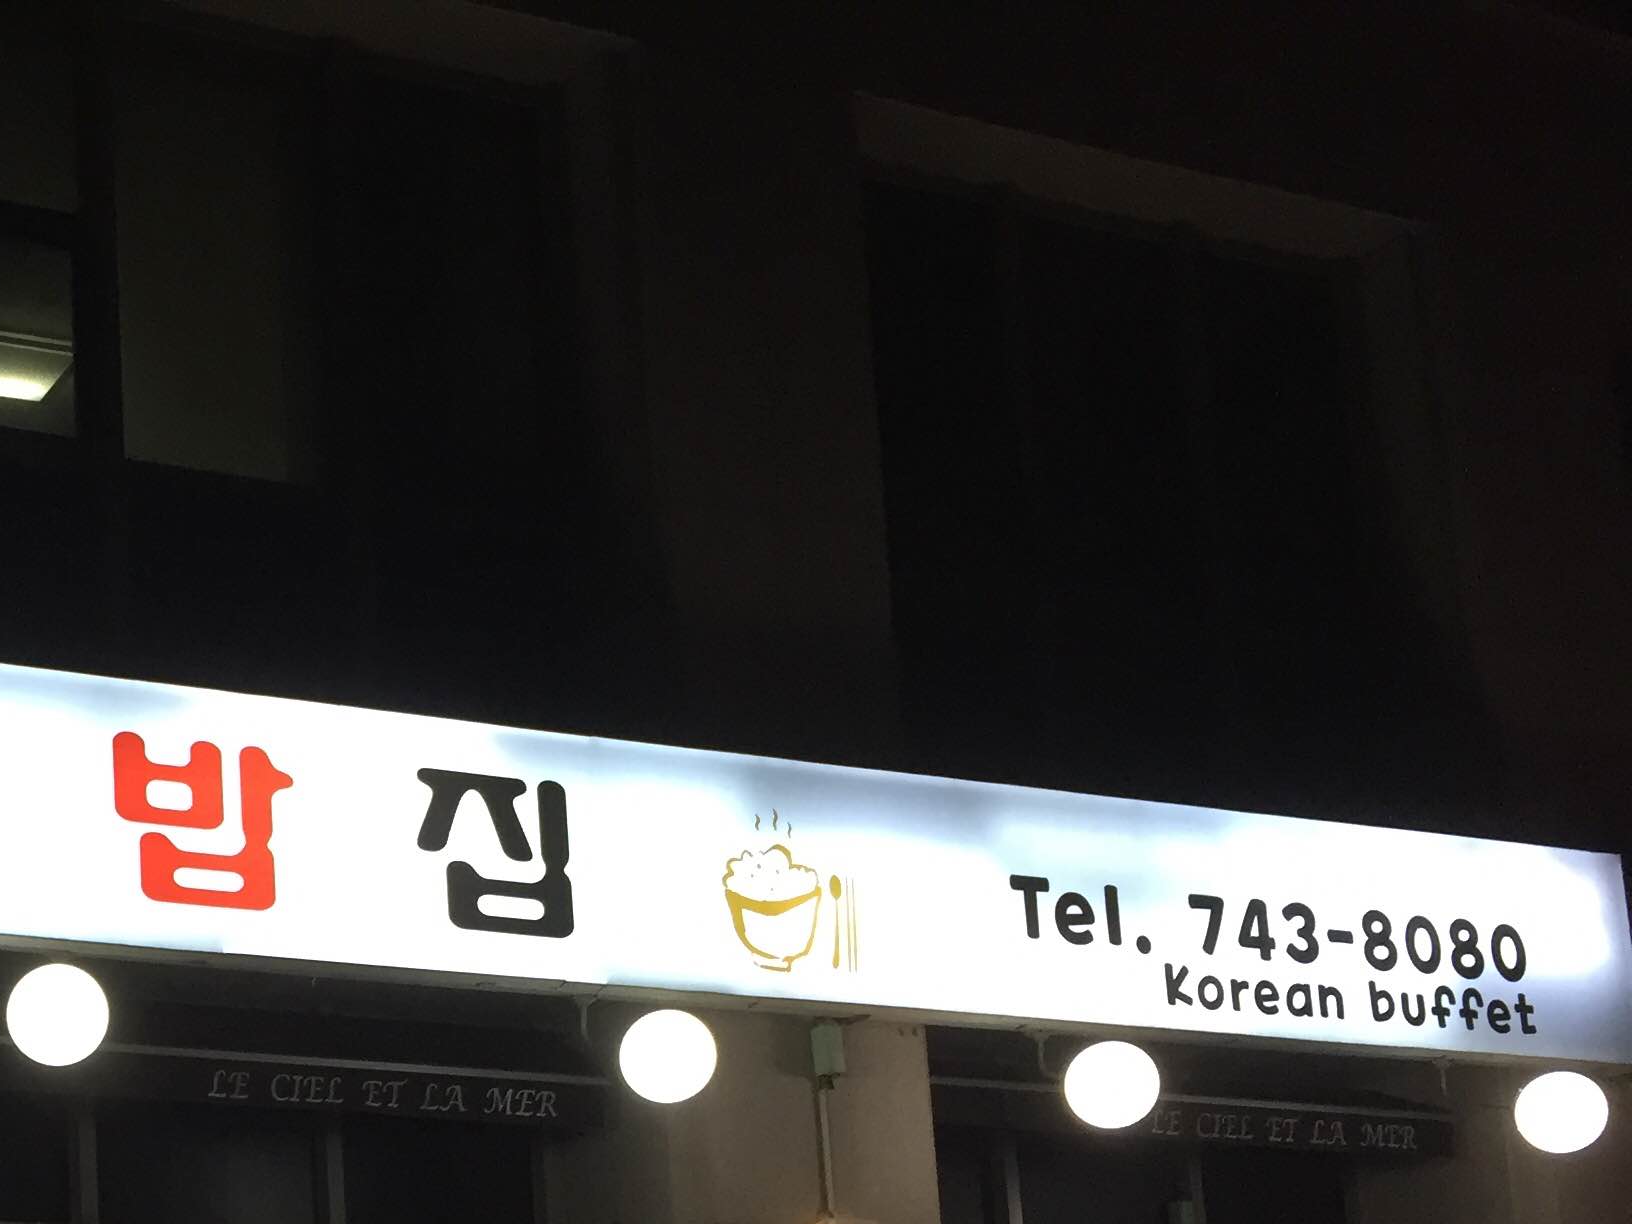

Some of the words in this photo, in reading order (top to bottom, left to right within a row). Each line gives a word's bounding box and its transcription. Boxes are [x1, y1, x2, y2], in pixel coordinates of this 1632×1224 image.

[1009, 874, 1152, 955] Tel.
[1188, 893, 1527, 983] 743-8080
[1164, 962, 1344, 1020] Korean
[1368, 981, 1537, 1035] buffet
[208, 1070, 250, 1099] LE
[270, 1073, 344, 1104] CIEL
[362, 1079, 408, 1109] ET
[420, 1082, 468, 1112] LA
[483, 1087, 558, 1118] MER
[1151, 1109, 1179, 1135] LE
[1196, 1113, 1253, 1141] CIEL
[1268, 1118, 1299, 1144] ET
[1309, 1119, 1346, 1146] LA
[1360, 1123, 1417, 1150] MER
